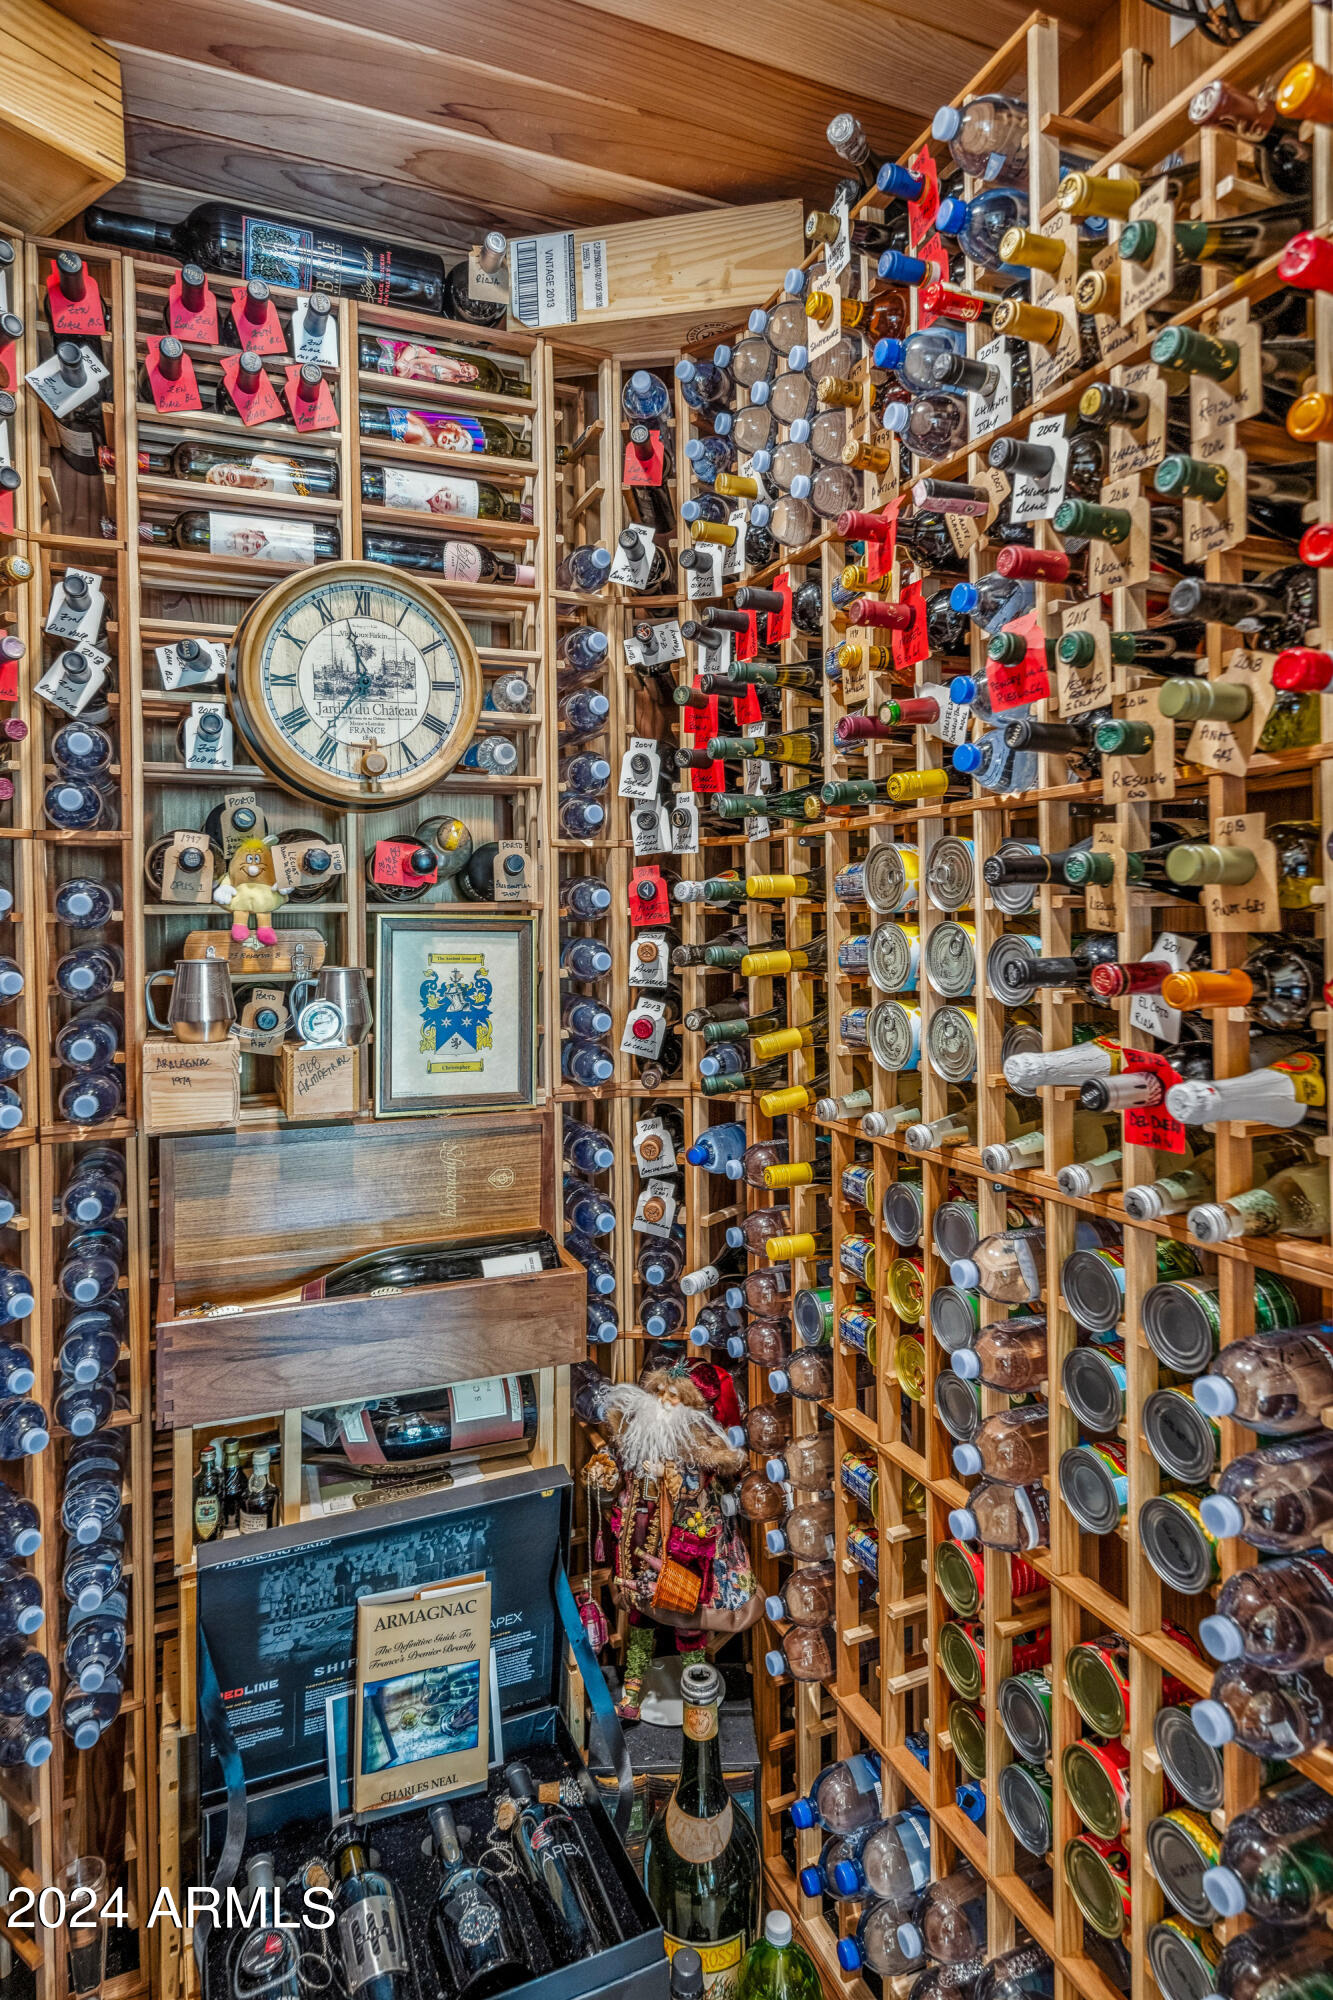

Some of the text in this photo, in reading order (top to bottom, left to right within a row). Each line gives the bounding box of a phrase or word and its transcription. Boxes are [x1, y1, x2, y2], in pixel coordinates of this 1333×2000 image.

[545, 249, 556, 308] VINTAGE 2013
[354, 591, 371, 617] XII
[396, 606, 409, 627] I
[422, 639, 444, 655] II
[432, 681, 456, 691] III
[280, 707, 311, 736] VIII
[315, 701, 418, 717] Jardin du Château
[315, 737, 339, 764] VII
[373, 1600, 478, 1632] ARMAGNAC
[368, 1654, 405, 1669] France's
[407, 1649, 441, 1661] Premier
[442, 1641, 476, 1654] Brandy
[375, 1628, 472, 1656] The Definitive Guide To
[314, 1658, 359, 1677] SHIF
[381, 1774, 459, 1801] CHARLES NEAL
[542, 1842, 584, 1863] APEX
[701, 1942, 737, 1968] ROSSI
